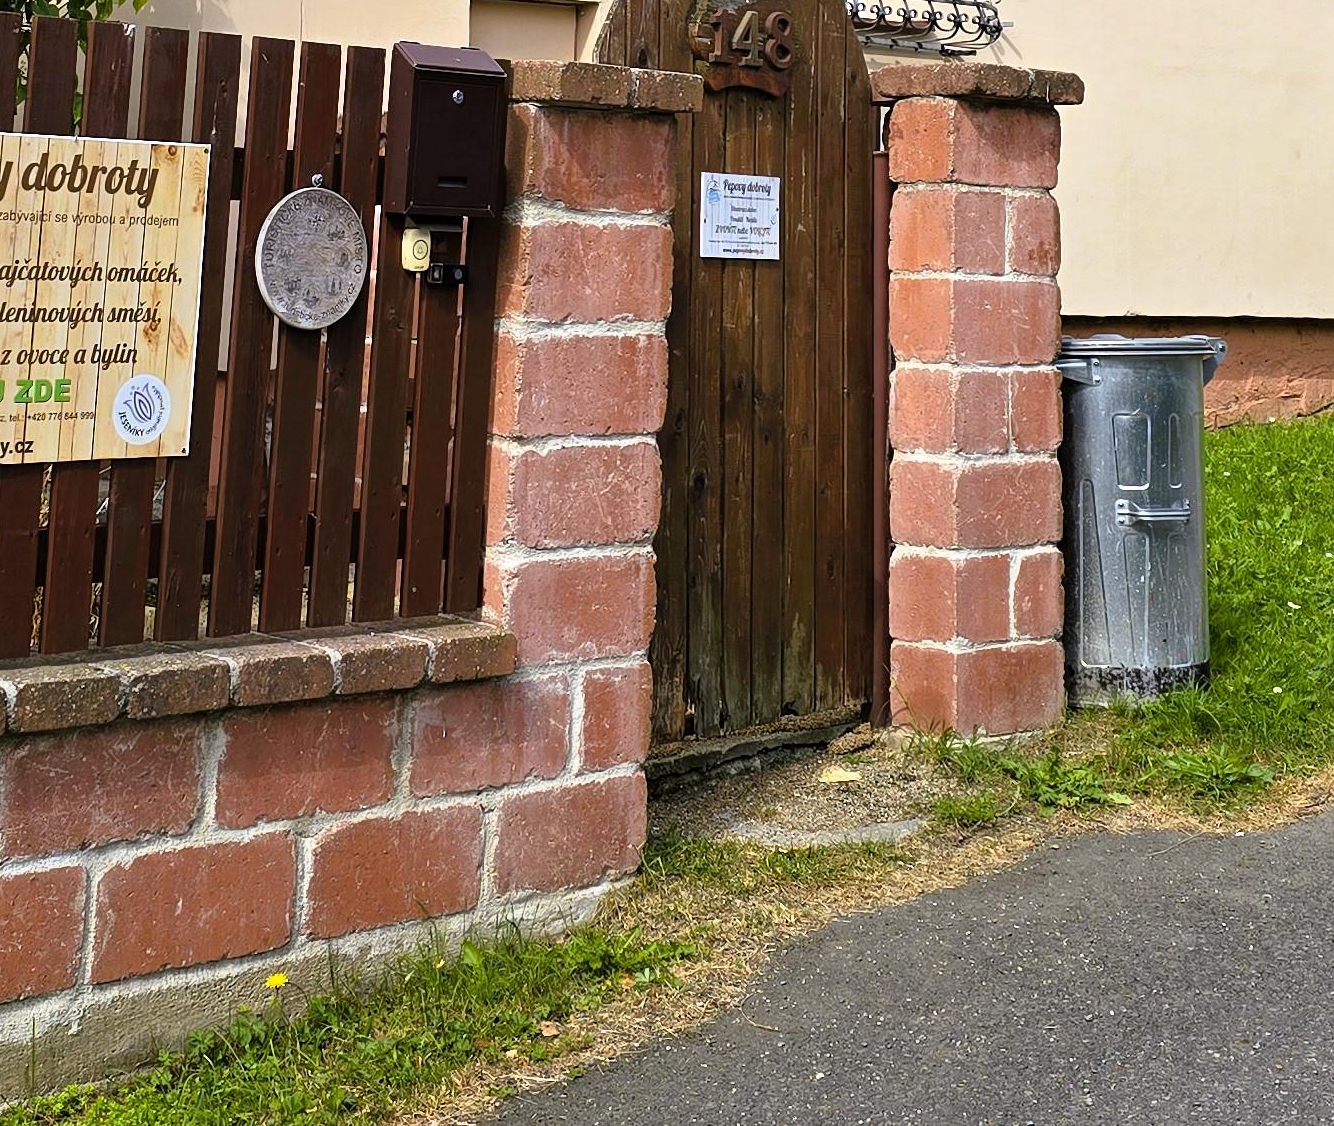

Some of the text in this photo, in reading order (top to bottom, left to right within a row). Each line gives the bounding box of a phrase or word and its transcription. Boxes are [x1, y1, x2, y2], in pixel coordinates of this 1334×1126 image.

[708, 8, 794, 70] 148
[21, 152, 159, 209] dobroty
[723, 179, 772, 196] Pepovy dobroty
[55, 214, 68, 223] se
[71, 212, 116, 226] výrobou
[119, 216, 126, 225] a
[129, 214, 179, 228] prodejem
[107, 261, 182, 285] omáček,
[107, 301, 162, 324] směsí,
[1, 349, 12, 365] z
[17, 349, 69, 365] ovoce
[74, 349, 86, 364] a
[91, 343, 138, 370] bylin
[13, 378, 72, 404] ZDE
[27, 413, 46, 421] +420
[48, 412, 62, 421] 776
[80, 411, 95, 420] 999
